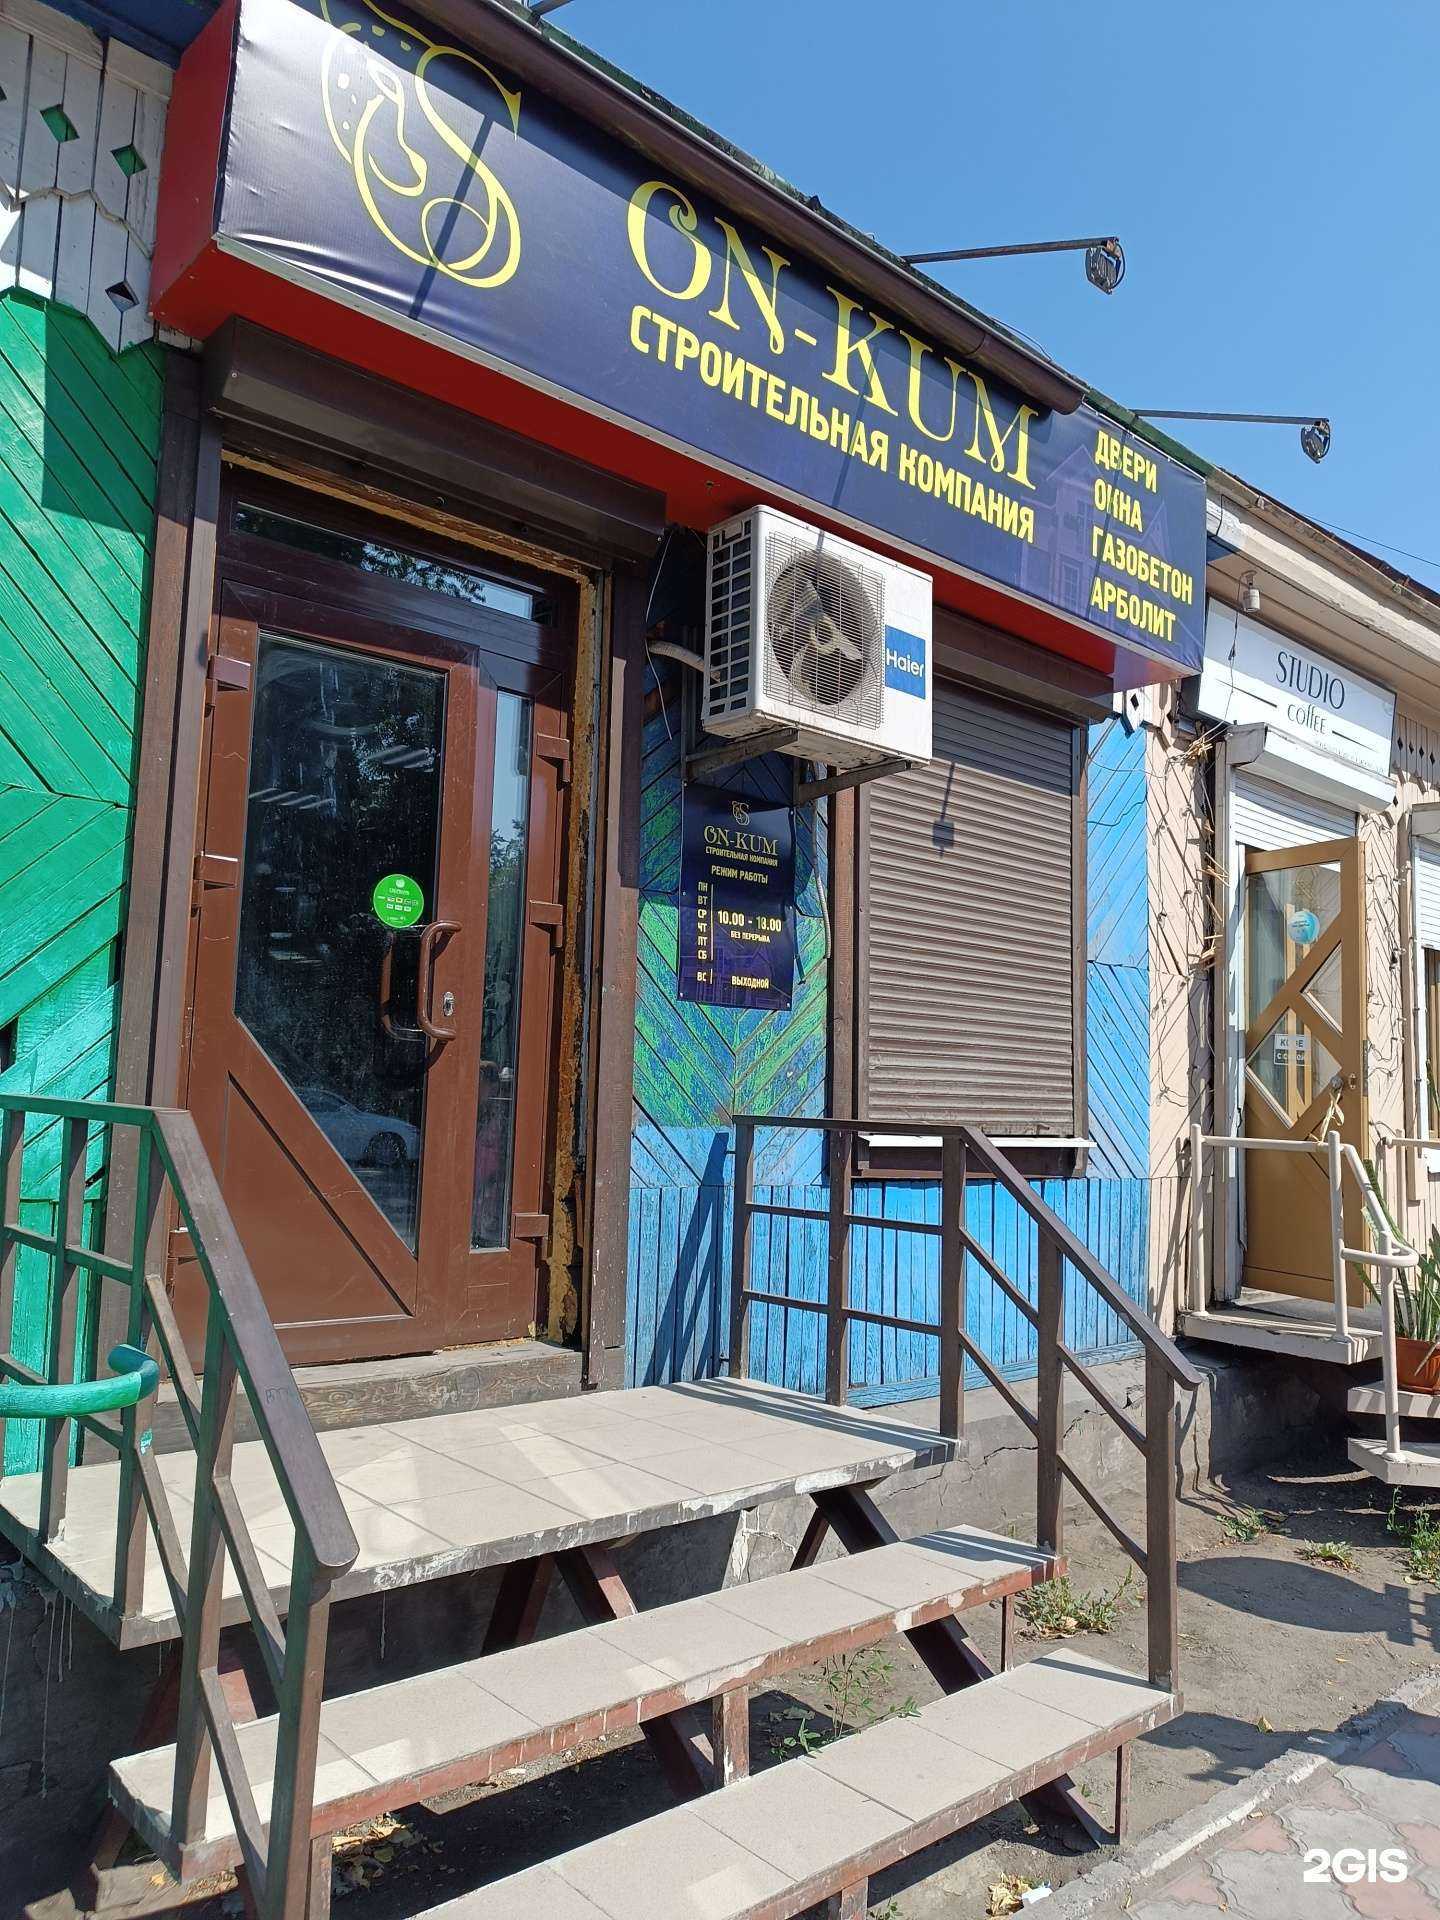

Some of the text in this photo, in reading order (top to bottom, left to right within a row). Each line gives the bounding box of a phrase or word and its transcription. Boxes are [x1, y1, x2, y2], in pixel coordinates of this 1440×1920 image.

[630, 305, 1035, 544] СТРОИТЕЛЬНАЯ КОМПАНИЯ
[1094, 430, 1157, 493] ДВЕРИ
[1094, 478, 1143, 532] ОКНА
[1092, 525, 1193, 605] ГАЗОБЕТОН
[1090, 576, 1176, 642] АРБОЛИТ
[886, 648, 925, 678] Haier
[1276, 651, 1345, 710] STUDIO
[705, 846, 778, 867] СТРОИТЕЛЬНАЯ КОМПАНИЯ
[711, 865, 768, 885] РЕЖИМ РАБОТЫ
[698, 881, 708, 892] ПН
[698, 895, 708, 905] ВТ
[697, 909, 707, 919] СР
[718, 909, 745, 926] 10.00
[697, 922, 707, 932] ЧТ
[731, 930, 770, 943] БЕЗ ПЕРЕРЫВА
[697, 936, 707, 946] ПТ
[698, 949, 707, 959] СБ
[697, 971, 769, 989] ВС ВЫХОДНОЙ
